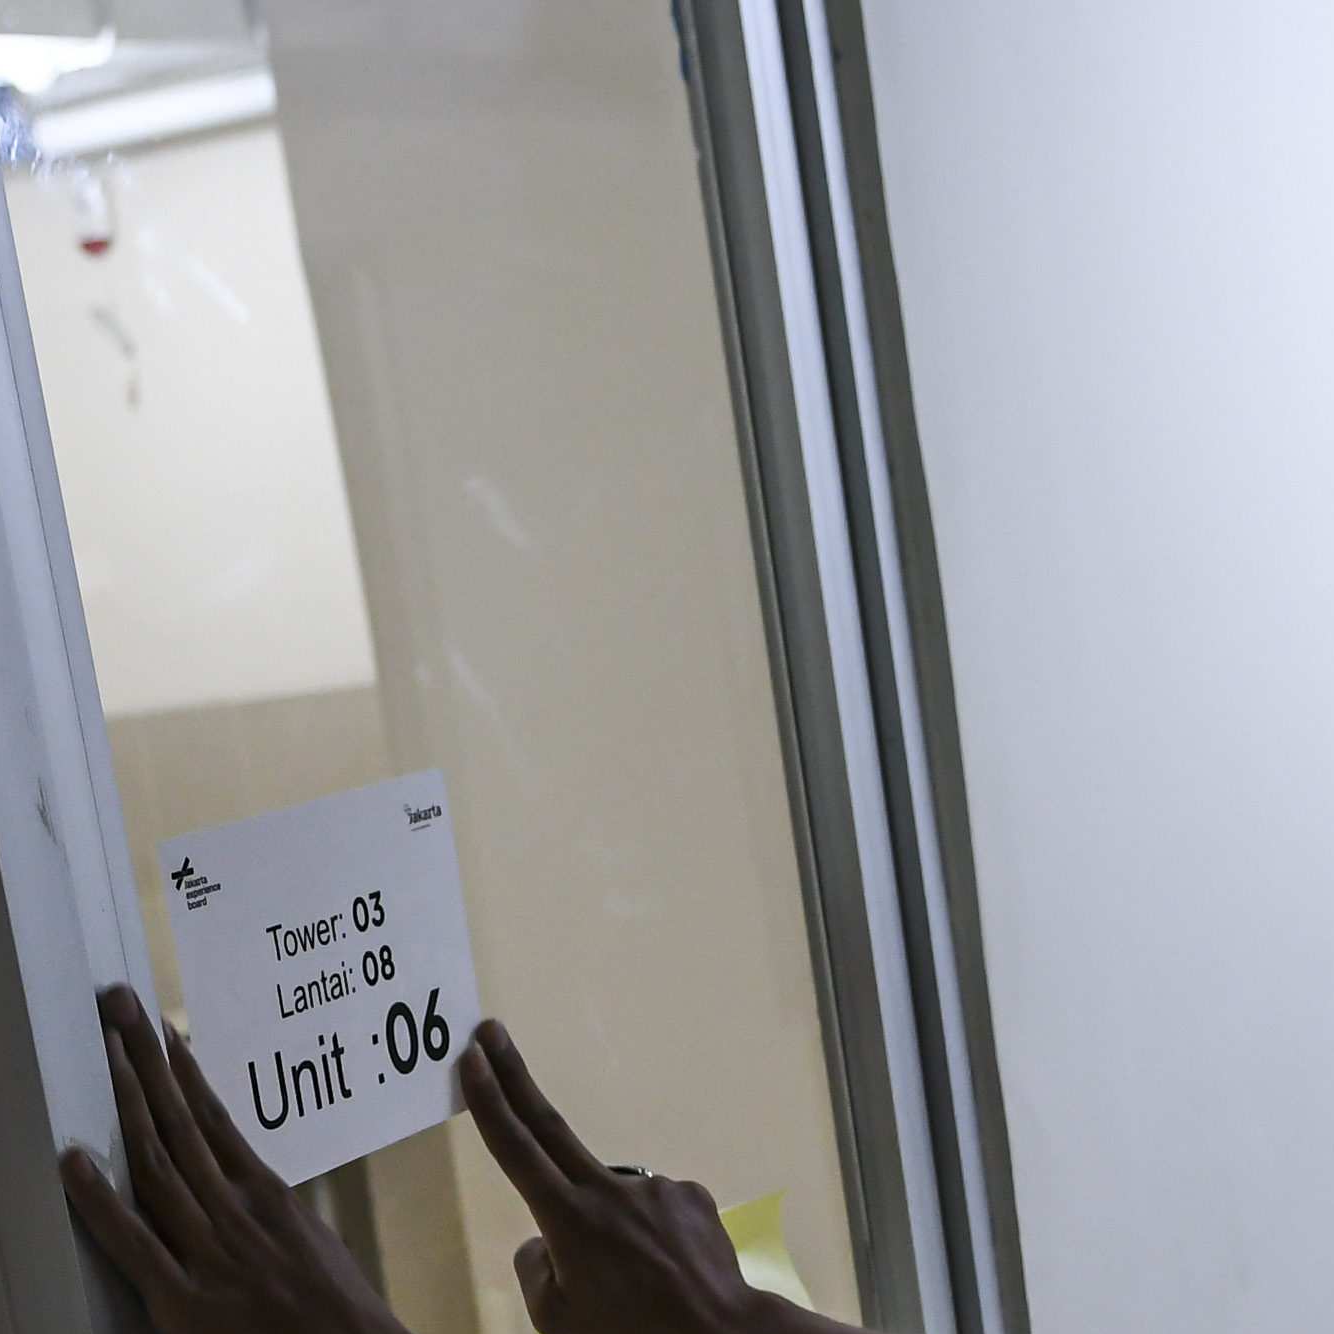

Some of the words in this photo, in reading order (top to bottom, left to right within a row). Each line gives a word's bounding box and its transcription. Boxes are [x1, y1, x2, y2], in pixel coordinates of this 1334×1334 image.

[187, 896, 208, 911] board
[266, 913, 346, 961] Tower:
[352, 890, 385, 932] 03
[276, 961, 356, 1019] Lantai:
[362, 944, 395, 987] 08
[247, 1031, 353, 1131] Unit
